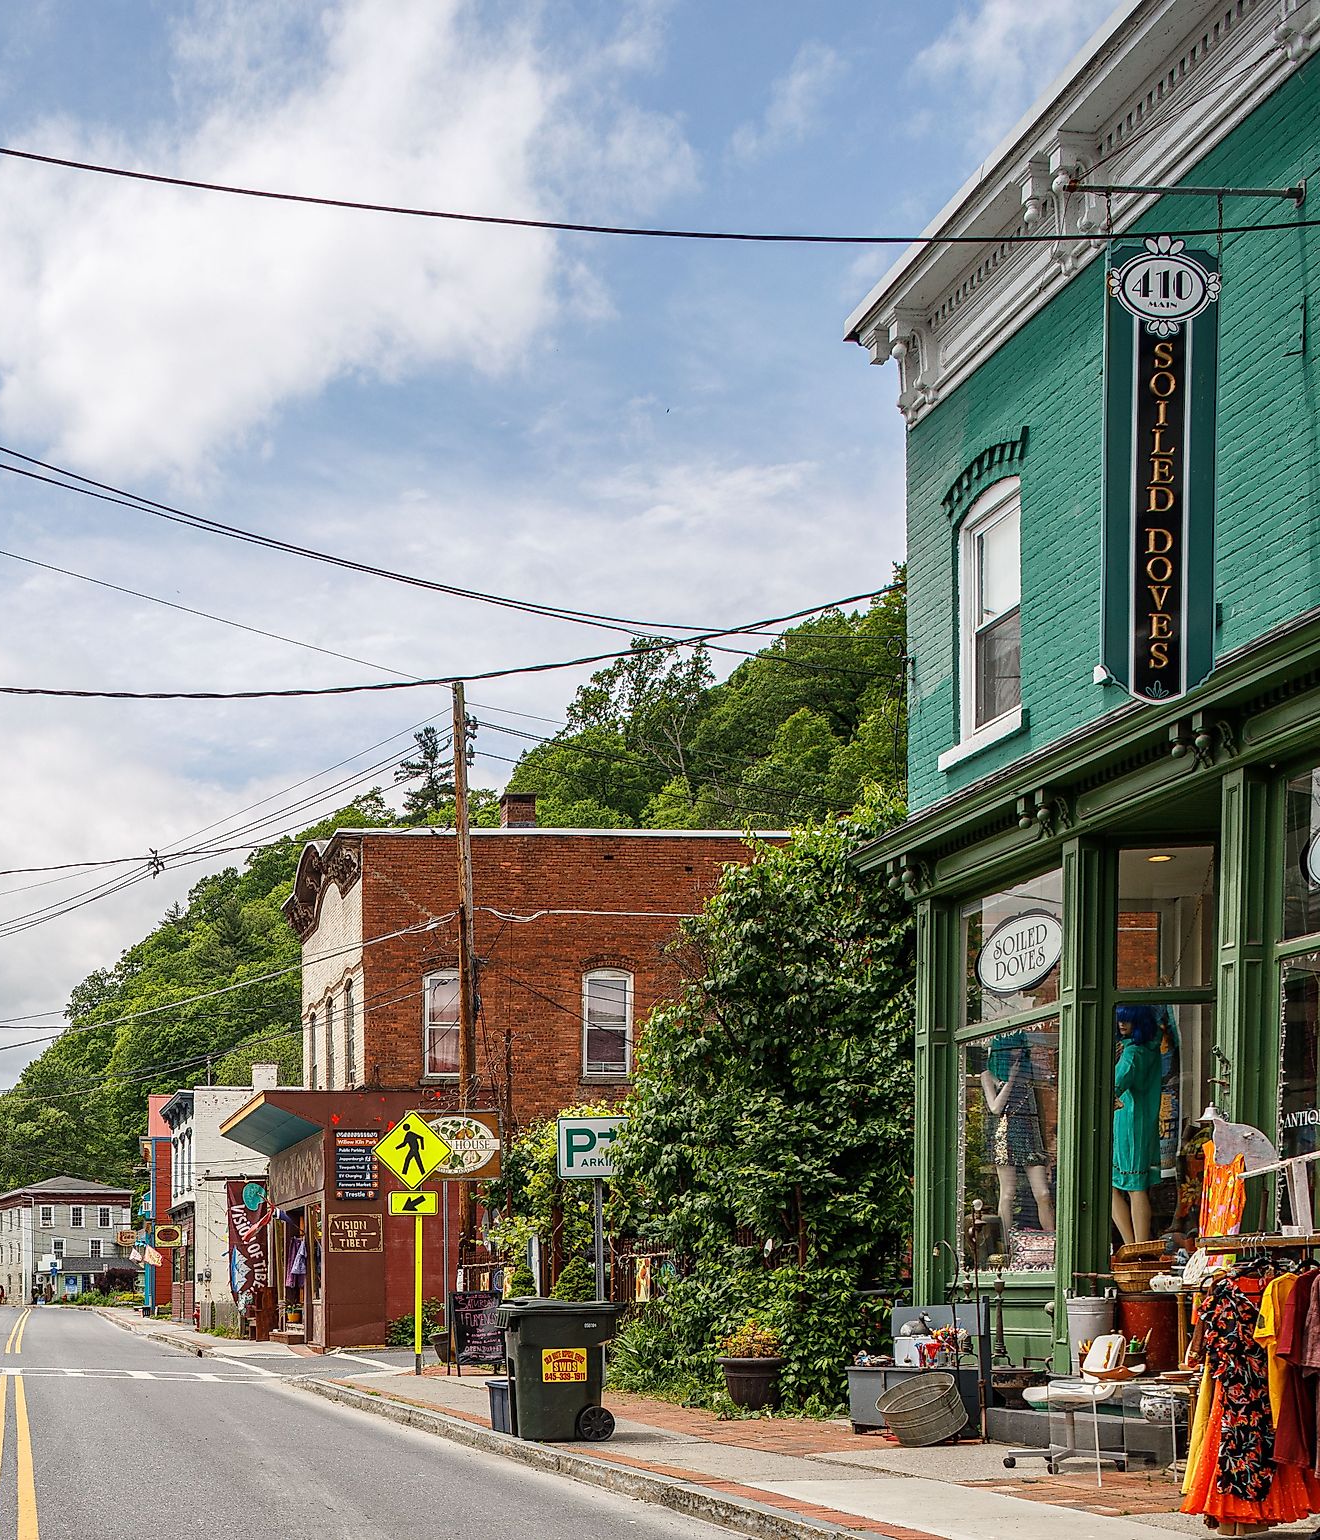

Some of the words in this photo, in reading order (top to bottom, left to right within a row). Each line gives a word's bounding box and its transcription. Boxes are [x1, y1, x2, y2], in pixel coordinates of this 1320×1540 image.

[1132, 267, 1193, 300] 410
[1148, 343, 1176, 512] SOILED
[1144, 528, 1174, 669] DOVES
[993, 923, 1048, 960] SOILED
[995, 946, 1046, 981] DOVES
[1283, 1109, 1320, 1128] ANTIQ
[455, 1140, 490, 1150] HOUSE
[334, 1220, 367, 1230] VISION
[339, 1238, 368, 1247] TIBET
[347, 1230, 358, 1238] OF
[247, 1243, 263, 1259] OF
[553, 1361, 577, 1372] SWDS
